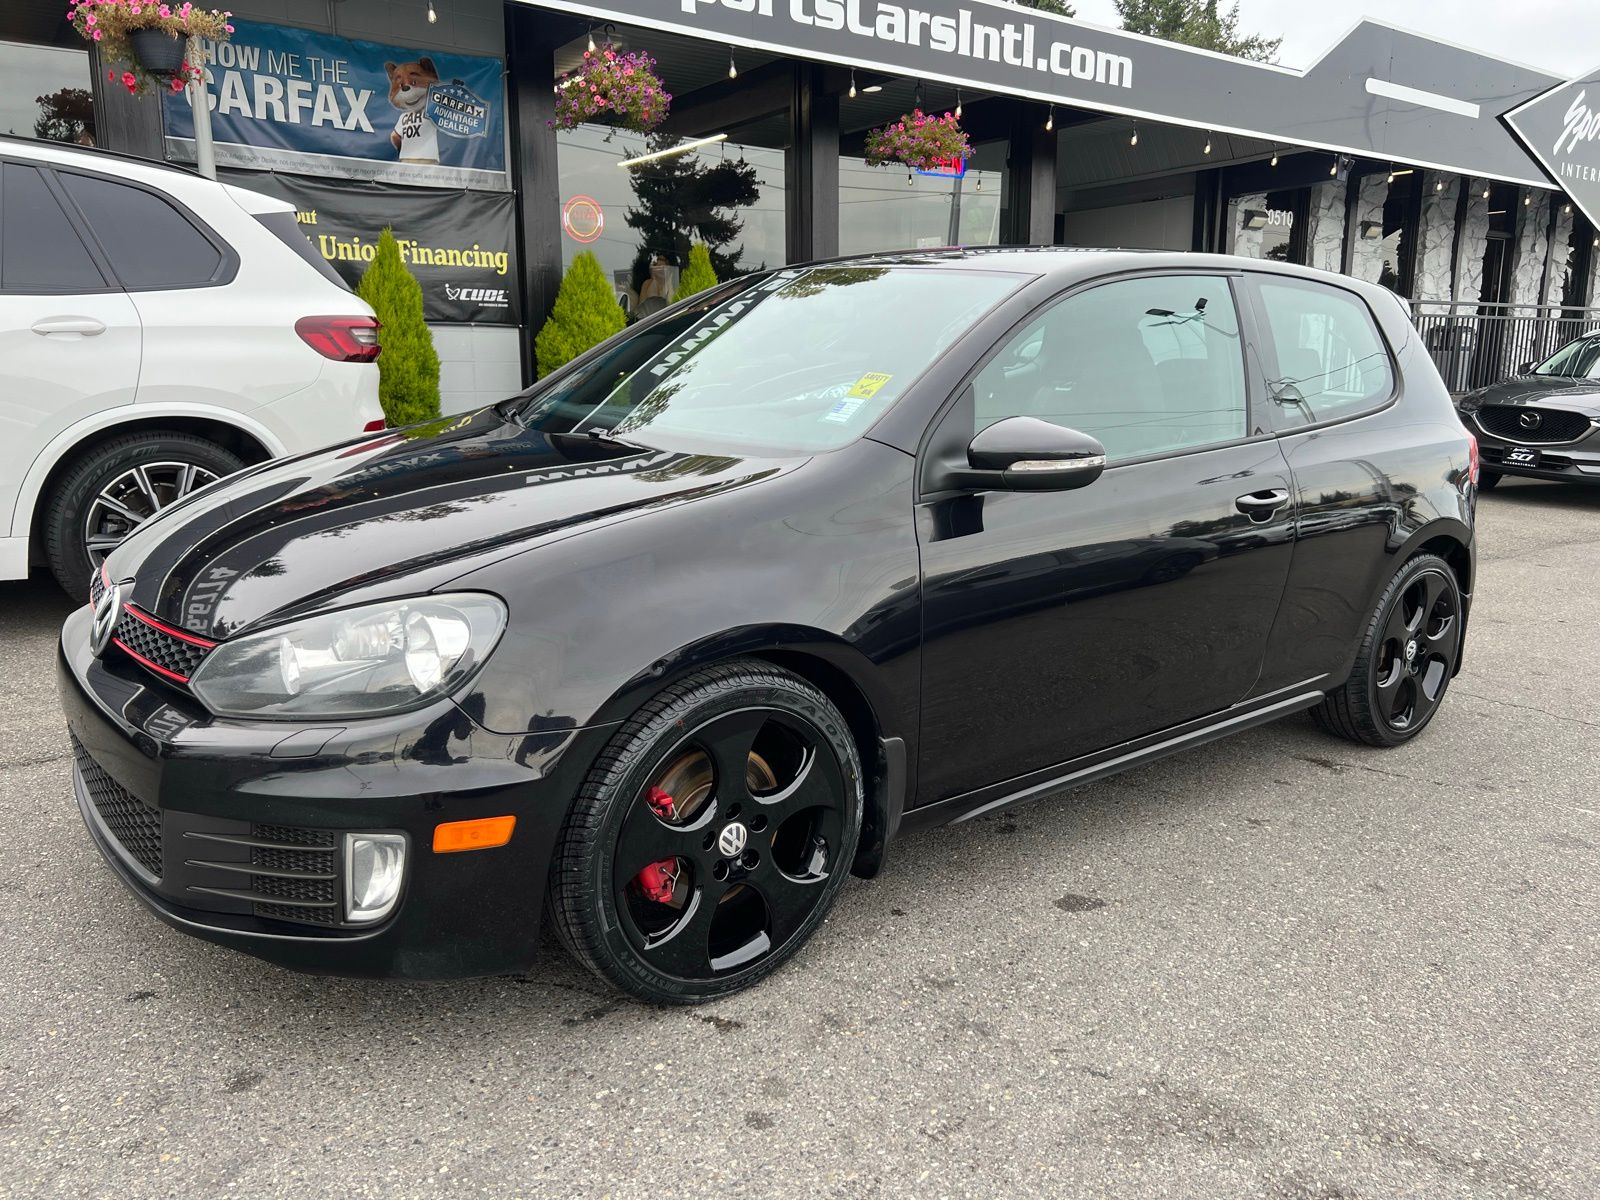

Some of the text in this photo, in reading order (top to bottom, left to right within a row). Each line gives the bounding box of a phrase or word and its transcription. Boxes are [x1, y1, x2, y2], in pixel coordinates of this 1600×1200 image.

[202, 39, 349, 85] HOW ME THE
[433, 94, 485, 118] CARFAX
[434, 106, 479, 128] ADVANTAGE
[402, 125, 421, 138] FOX
[438, 118, 470, 134] DEALER
[1553, 89, 1600, 156] Spo
[318, 234, 509, 275] Unio Financing
[459, 288, 509, 302] CUDL
